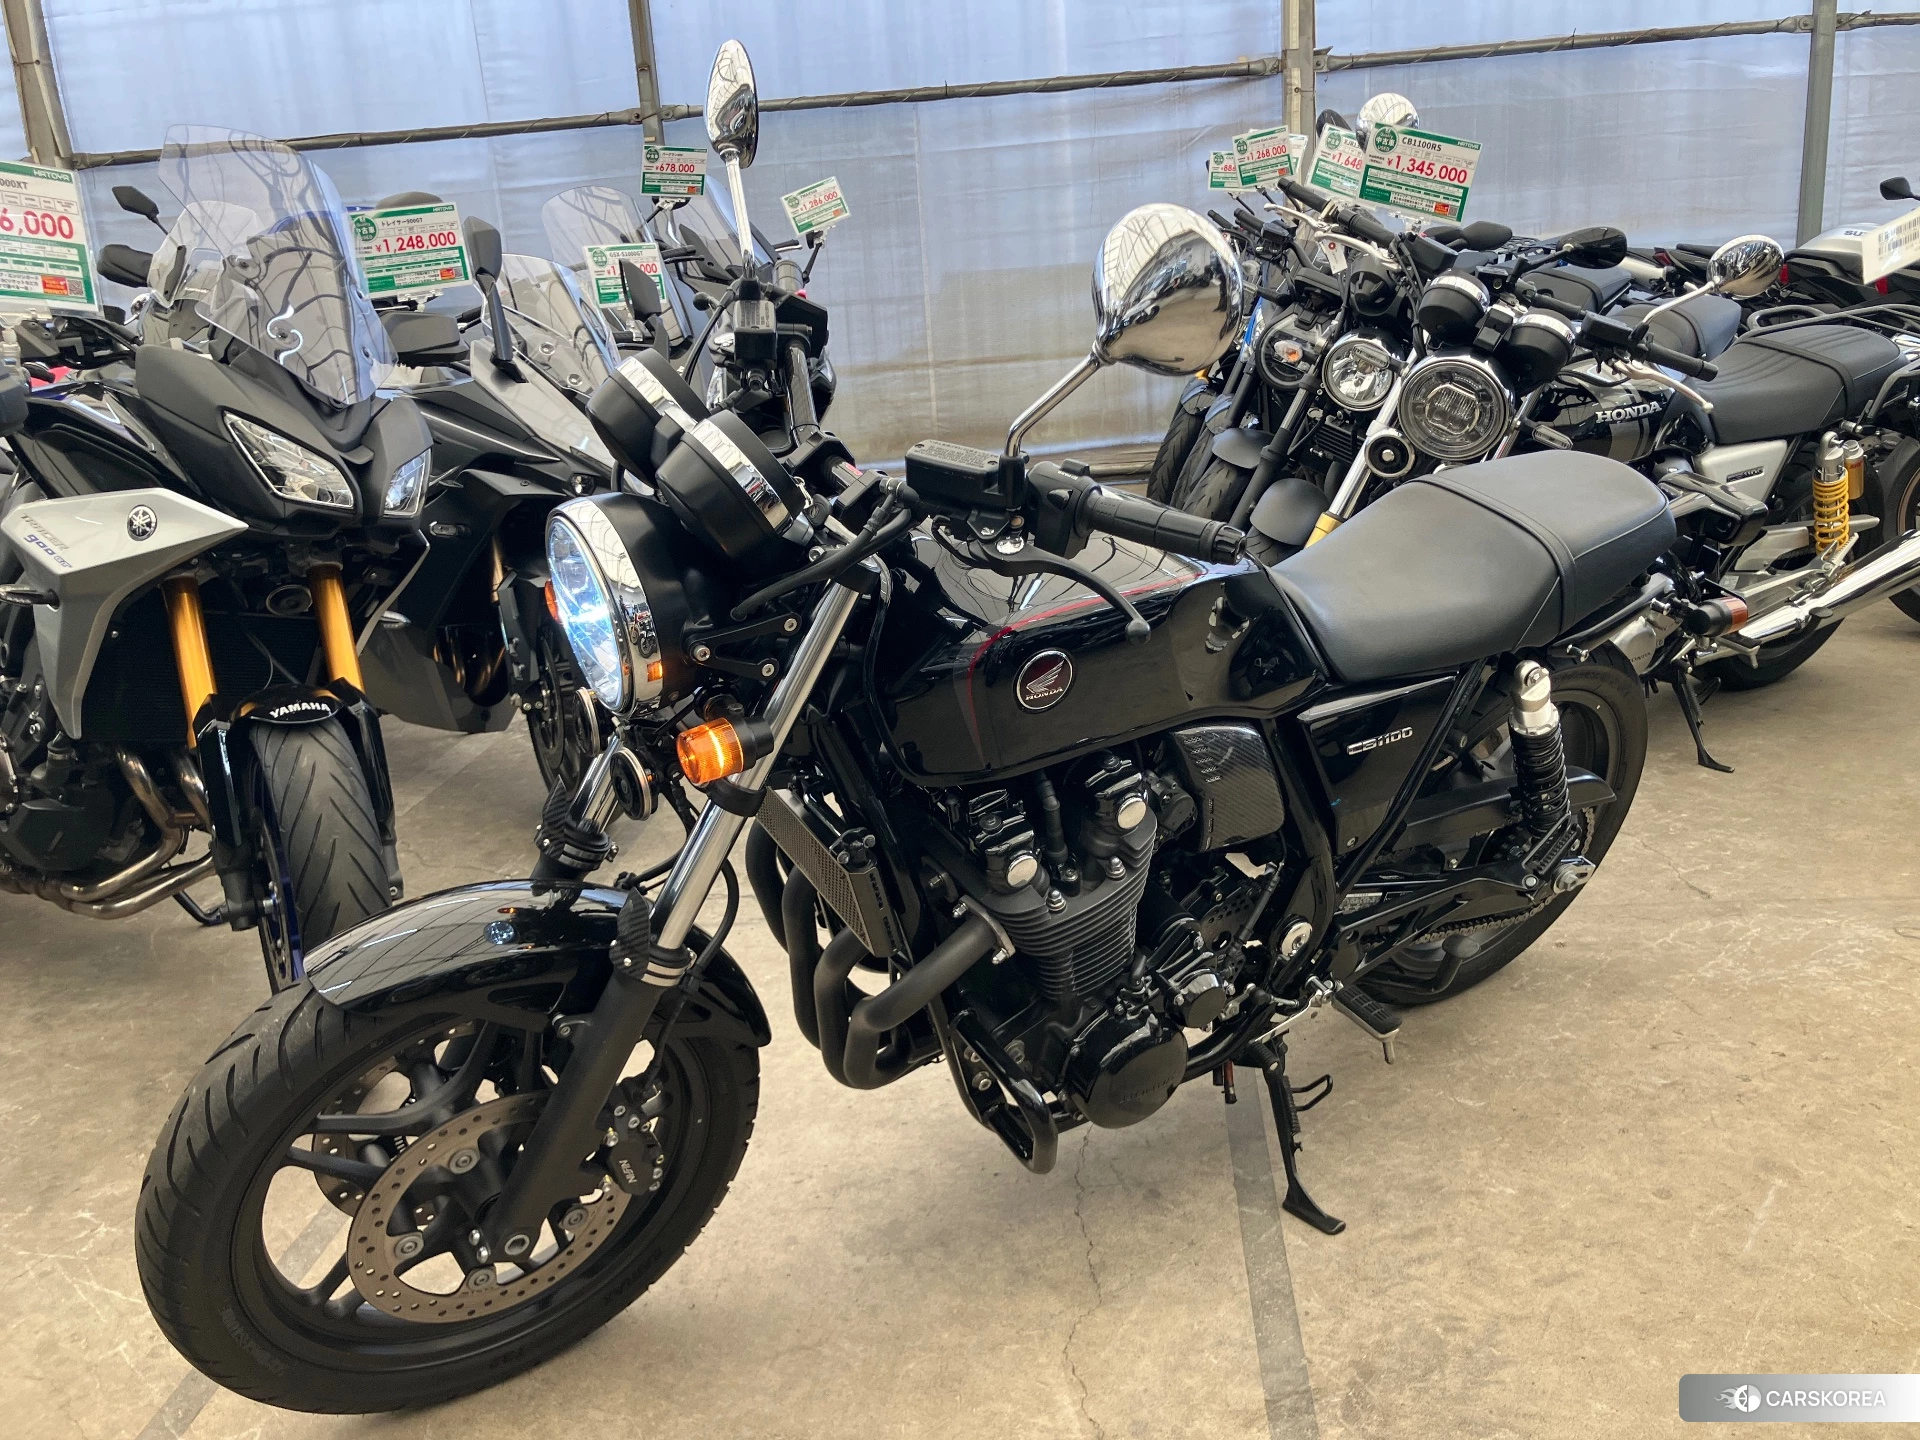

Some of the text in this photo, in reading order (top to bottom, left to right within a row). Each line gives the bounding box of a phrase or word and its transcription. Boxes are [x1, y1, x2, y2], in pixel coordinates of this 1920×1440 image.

[1402, 136, 1442, 152] CB1100RS
[33, 169, 70, 182] HATOYA
[655, 163, 695, 173] ¥678,000
[1387, 155, 1468, 184] ¥1,345,000
[0, 207, 74, 239] 6,000
[375, 231, 457, 254] ¥1,248,000
[1595, 400, 1663, 424] HONDA
[1025, 687, 1064, 701] HONDA
[269, 702, 331, 719] YAMAHA
[1346, 726, 1413, 756] CB1100
